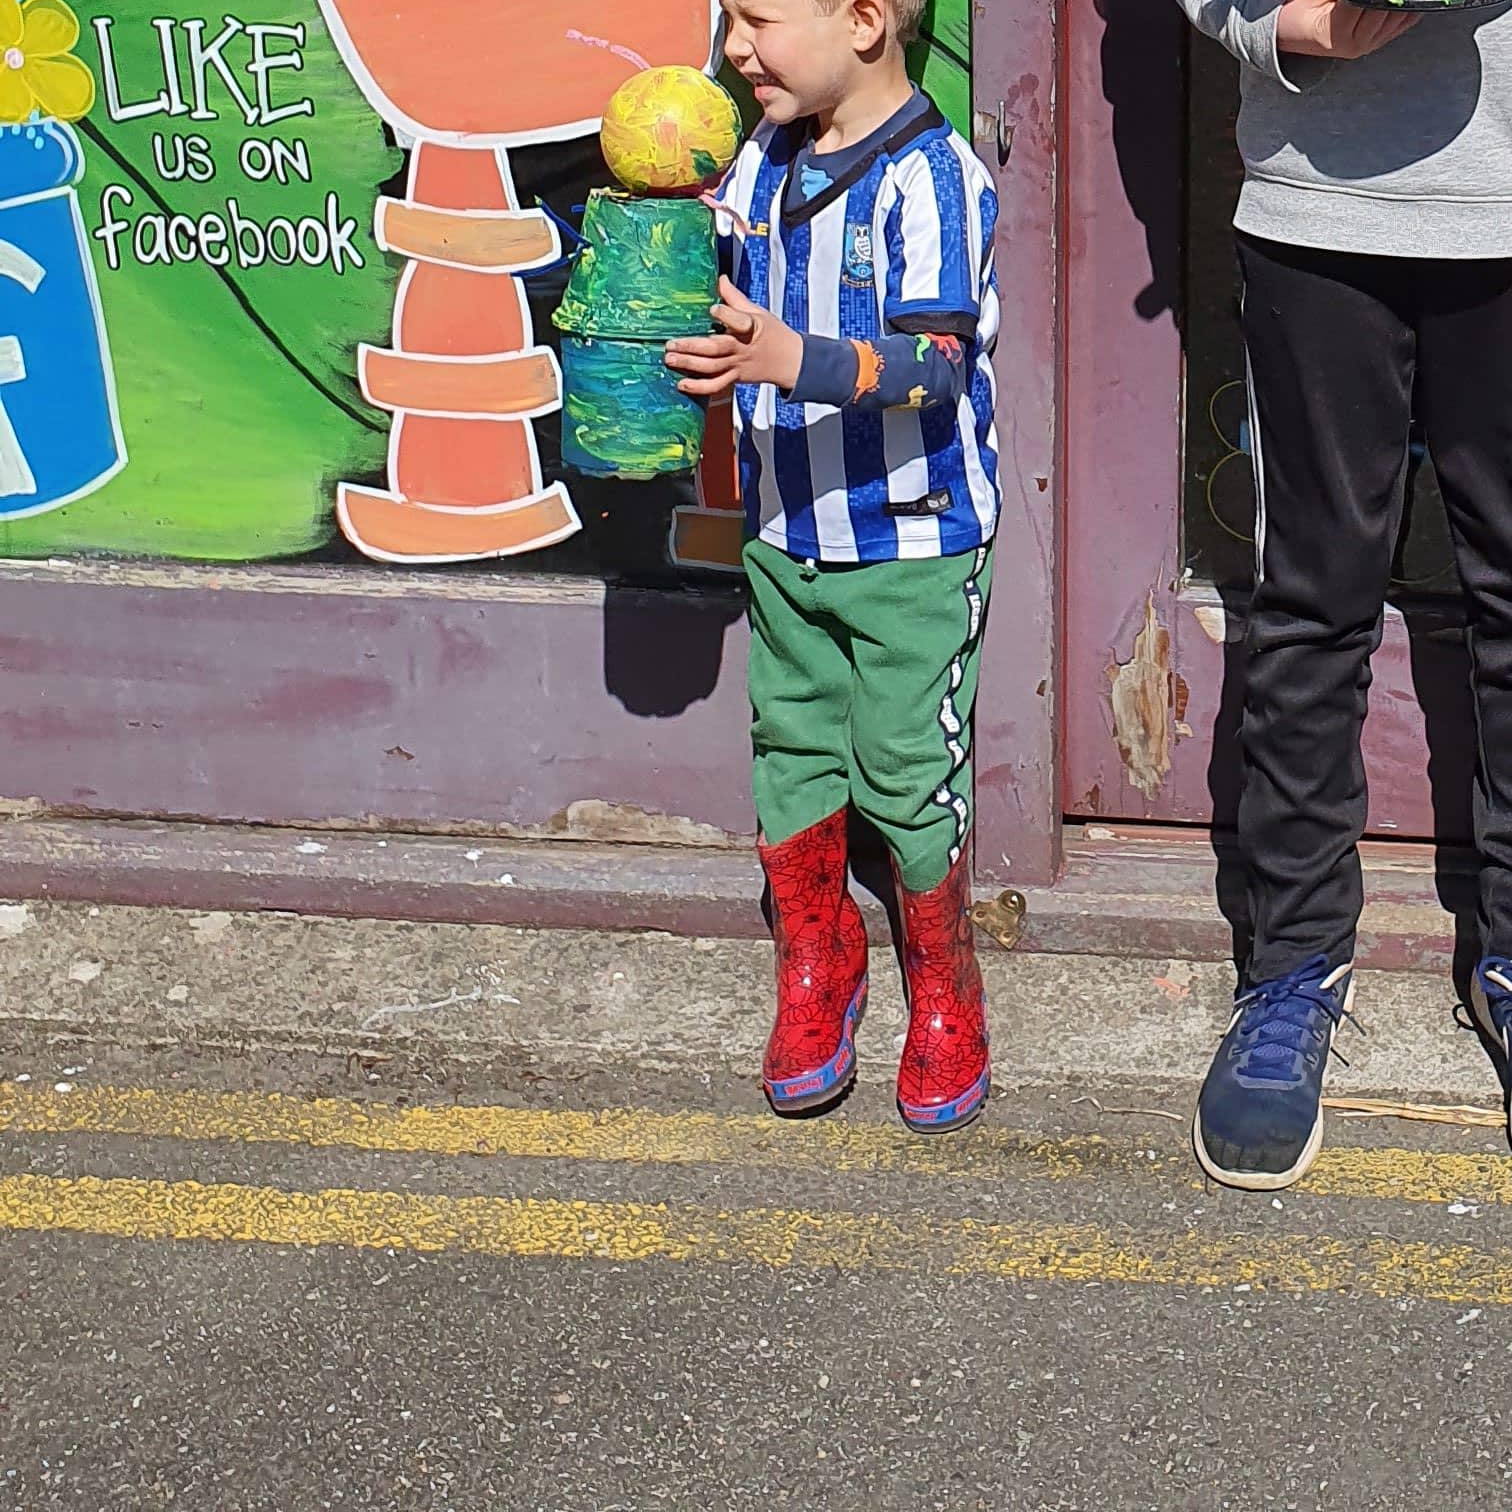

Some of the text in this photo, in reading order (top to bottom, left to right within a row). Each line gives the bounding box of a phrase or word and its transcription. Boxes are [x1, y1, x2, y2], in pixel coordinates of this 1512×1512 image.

[91, 15, 314, 127] LIKE
[153, 133, 312, 183] US ON
[94, 185, 365, 274] facebook
